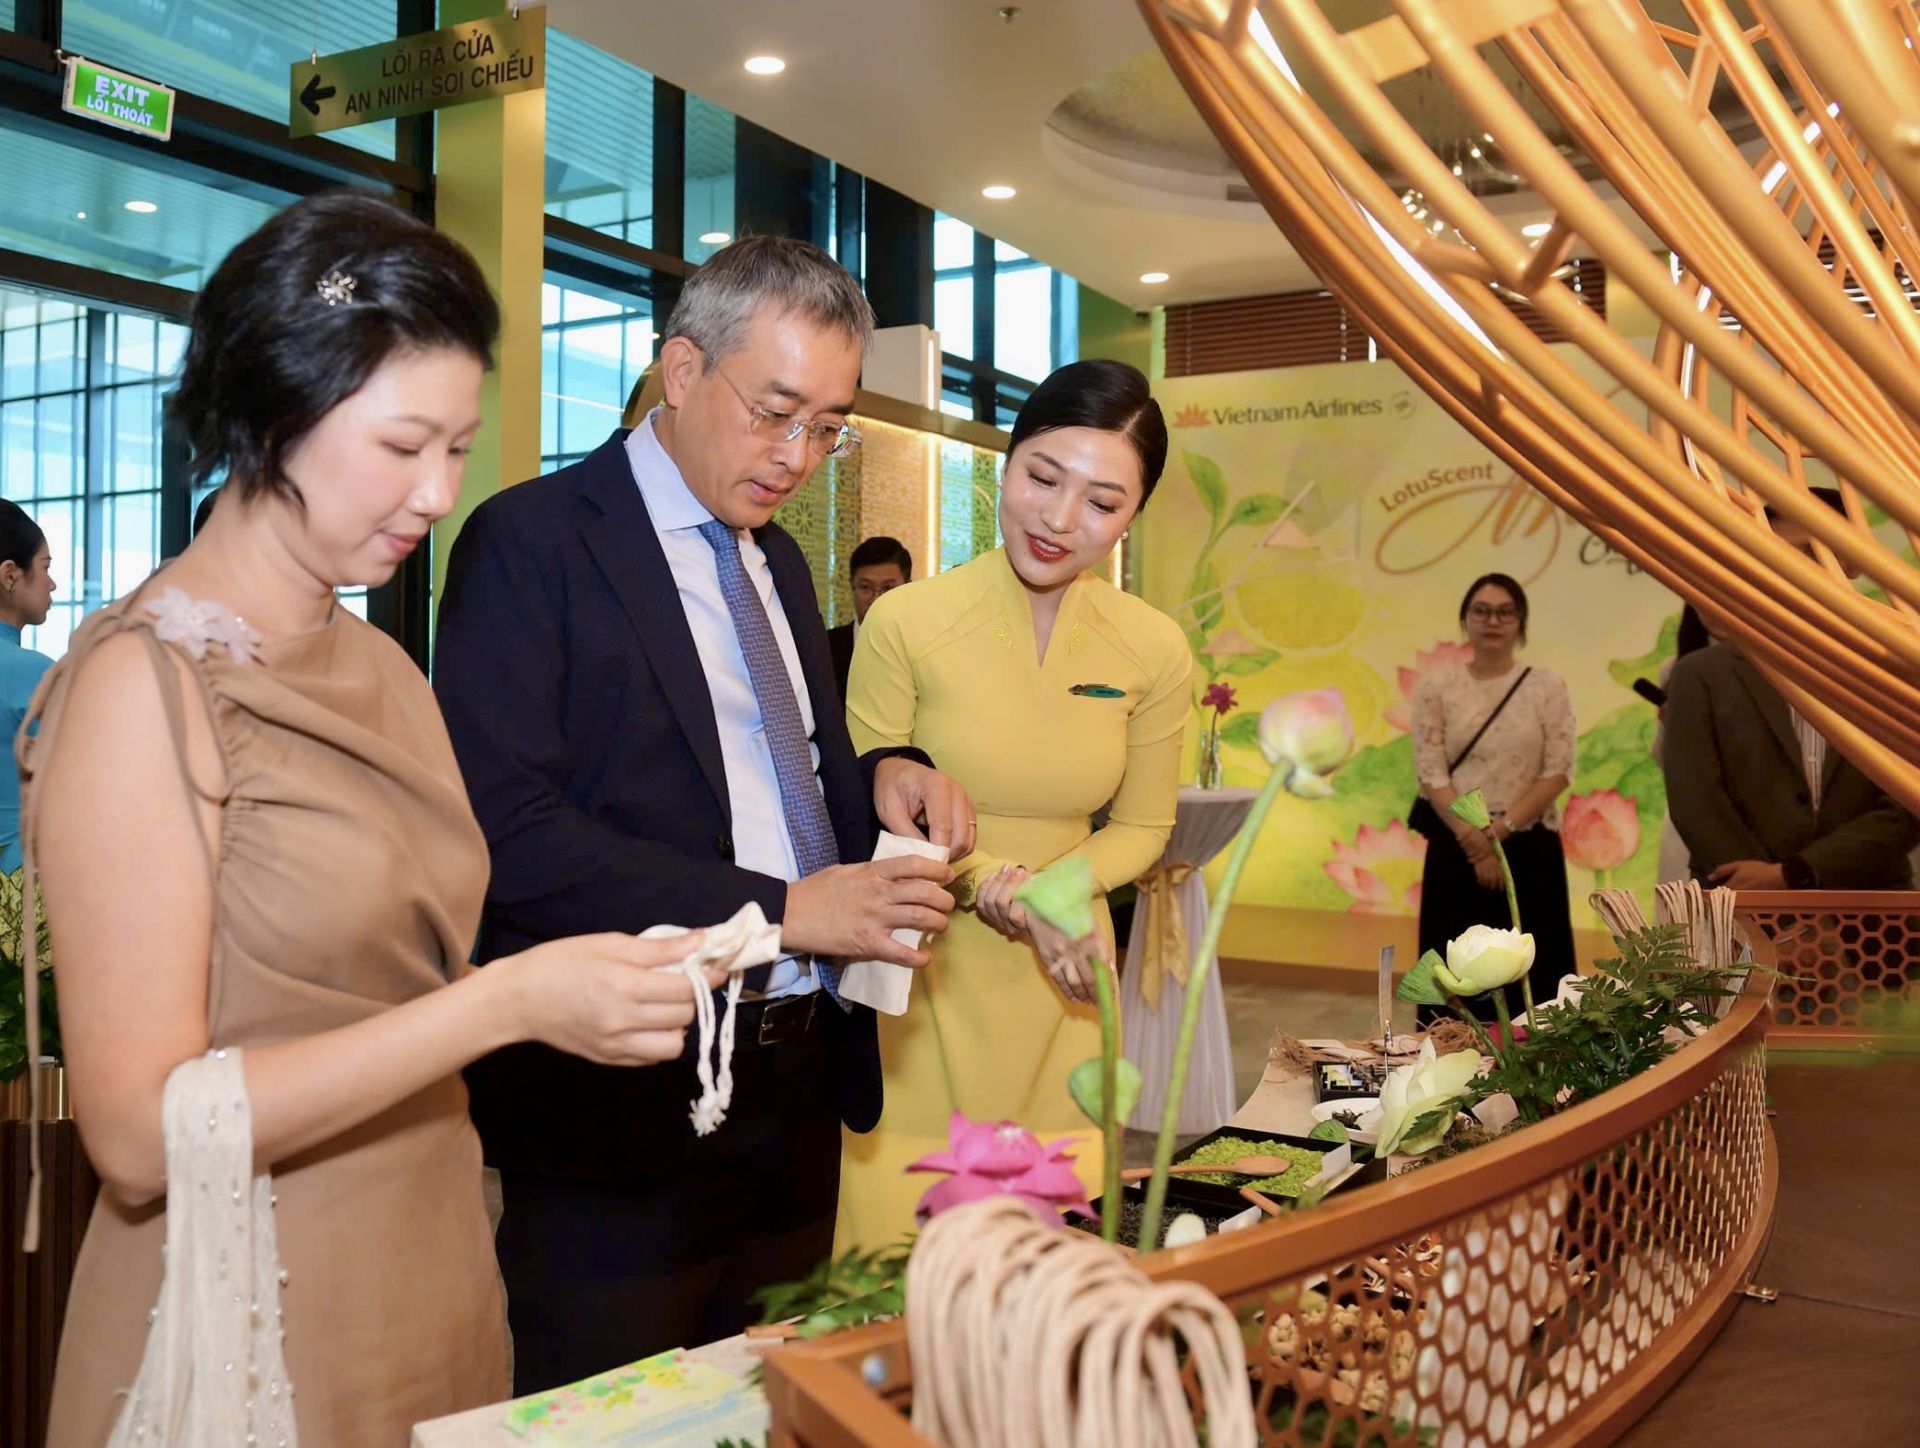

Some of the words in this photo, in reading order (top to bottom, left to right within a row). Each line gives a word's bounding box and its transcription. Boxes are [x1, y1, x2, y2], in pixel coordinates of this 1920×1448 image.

[419, 45, 445, 71] RA
[453, 29, 495, 62] CỬA
[96, 75, 149, 106] EXIT
[345, 91, 371, 115] AN
[378, 81, 424, 106] NINH
[431, 72, 464, 97] SOI
[471, 49, 534, 89] CHIẾU
[112, 103, 153, 127] THOÁT
[1213, 405, 1300, 425] Vietnam
[1302, 398, 1383, 419] Airlines
[1379, 462, 1493, 512] LotuScent
